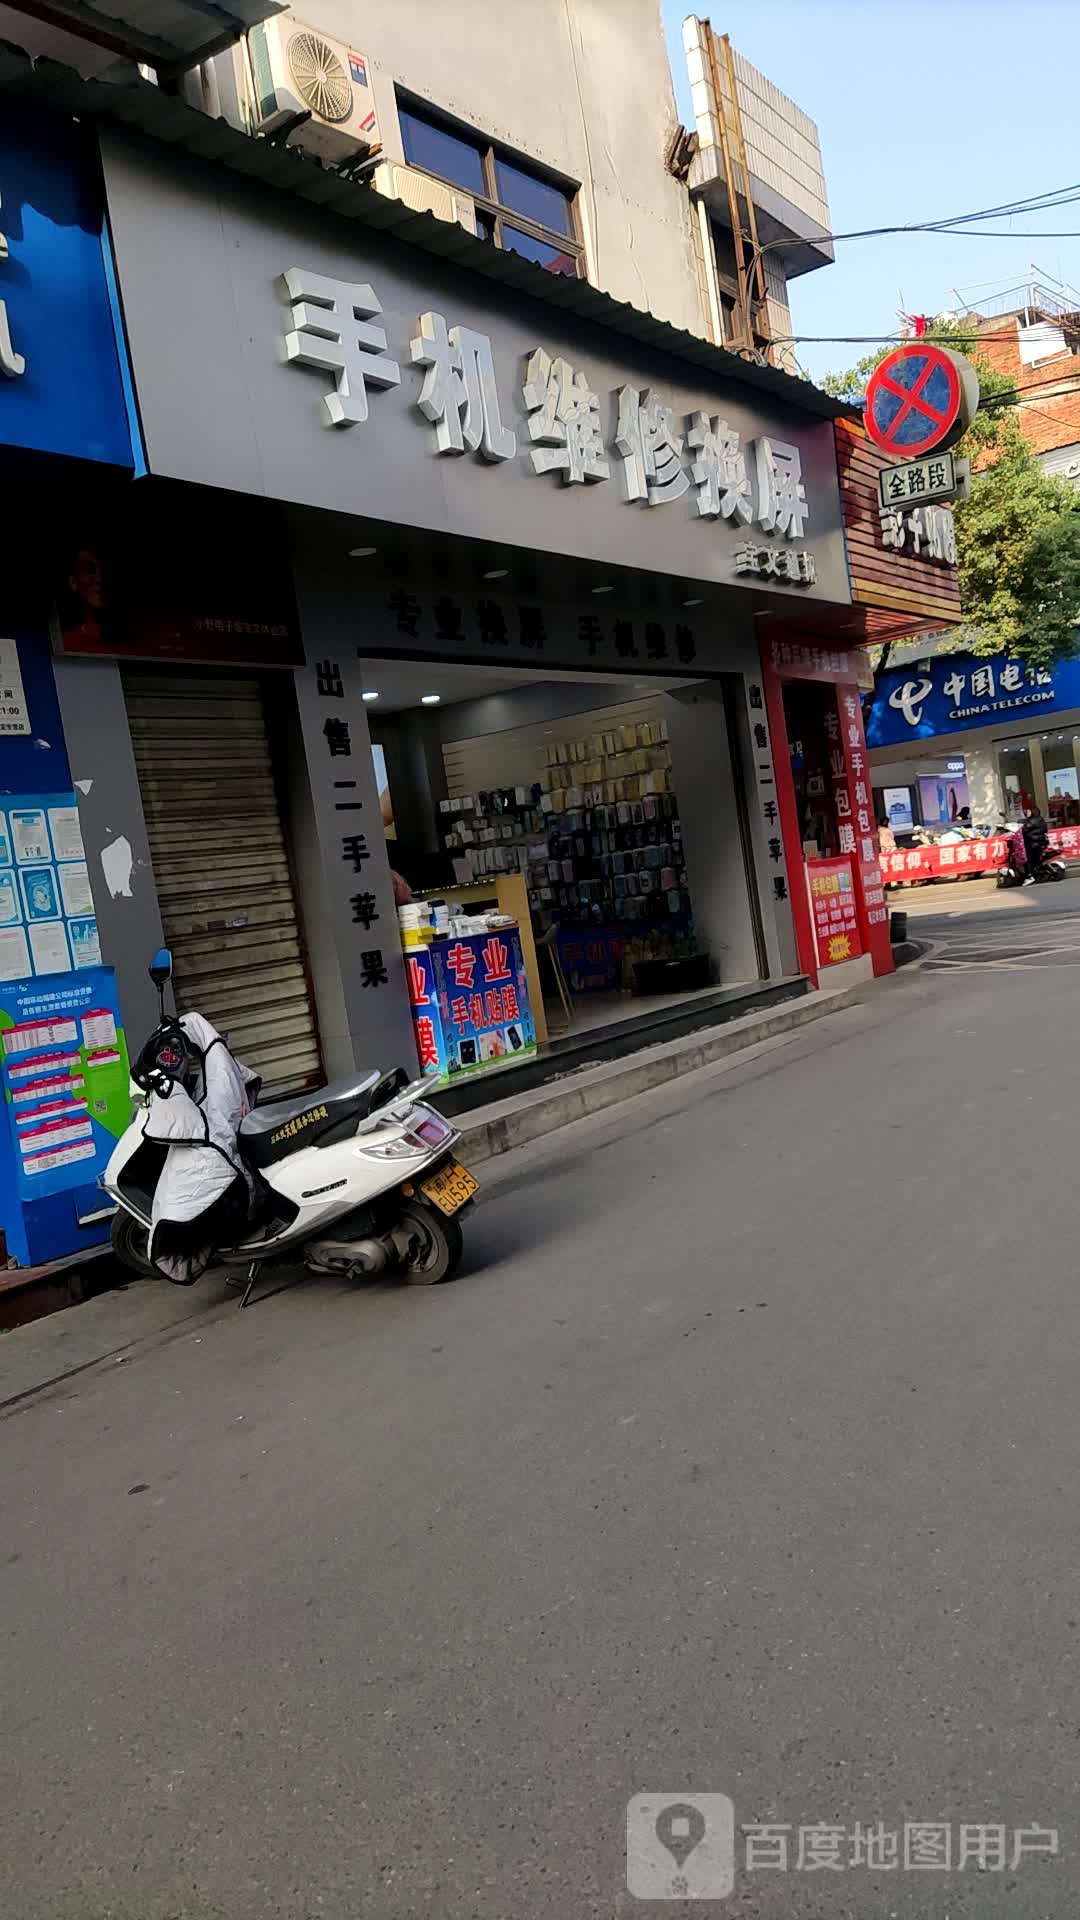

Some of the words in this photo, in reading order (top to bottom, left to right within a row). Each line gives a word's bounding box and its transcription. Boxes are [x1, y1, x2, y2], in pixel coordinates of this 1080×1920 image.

[281, 266, 810, 540] 手机维修换屏
[887, 461, 949, 499] 全路段
[0, 706, 20, 715] 1:00
[949, 704, 990, 719] CHINA
[991, 690, 1055, 711] TELECOM
[749, 684, 789, 902] 出售二手苹果
[823, 711, 857, 855] 专业包膜
[316, 659, 389, 989] 出售二手苹果
[446, 937, 512, 990] 专业
[451, 983, 520, 1036] 手机贴膜
[436, 1175, 478, 1214] EU595
